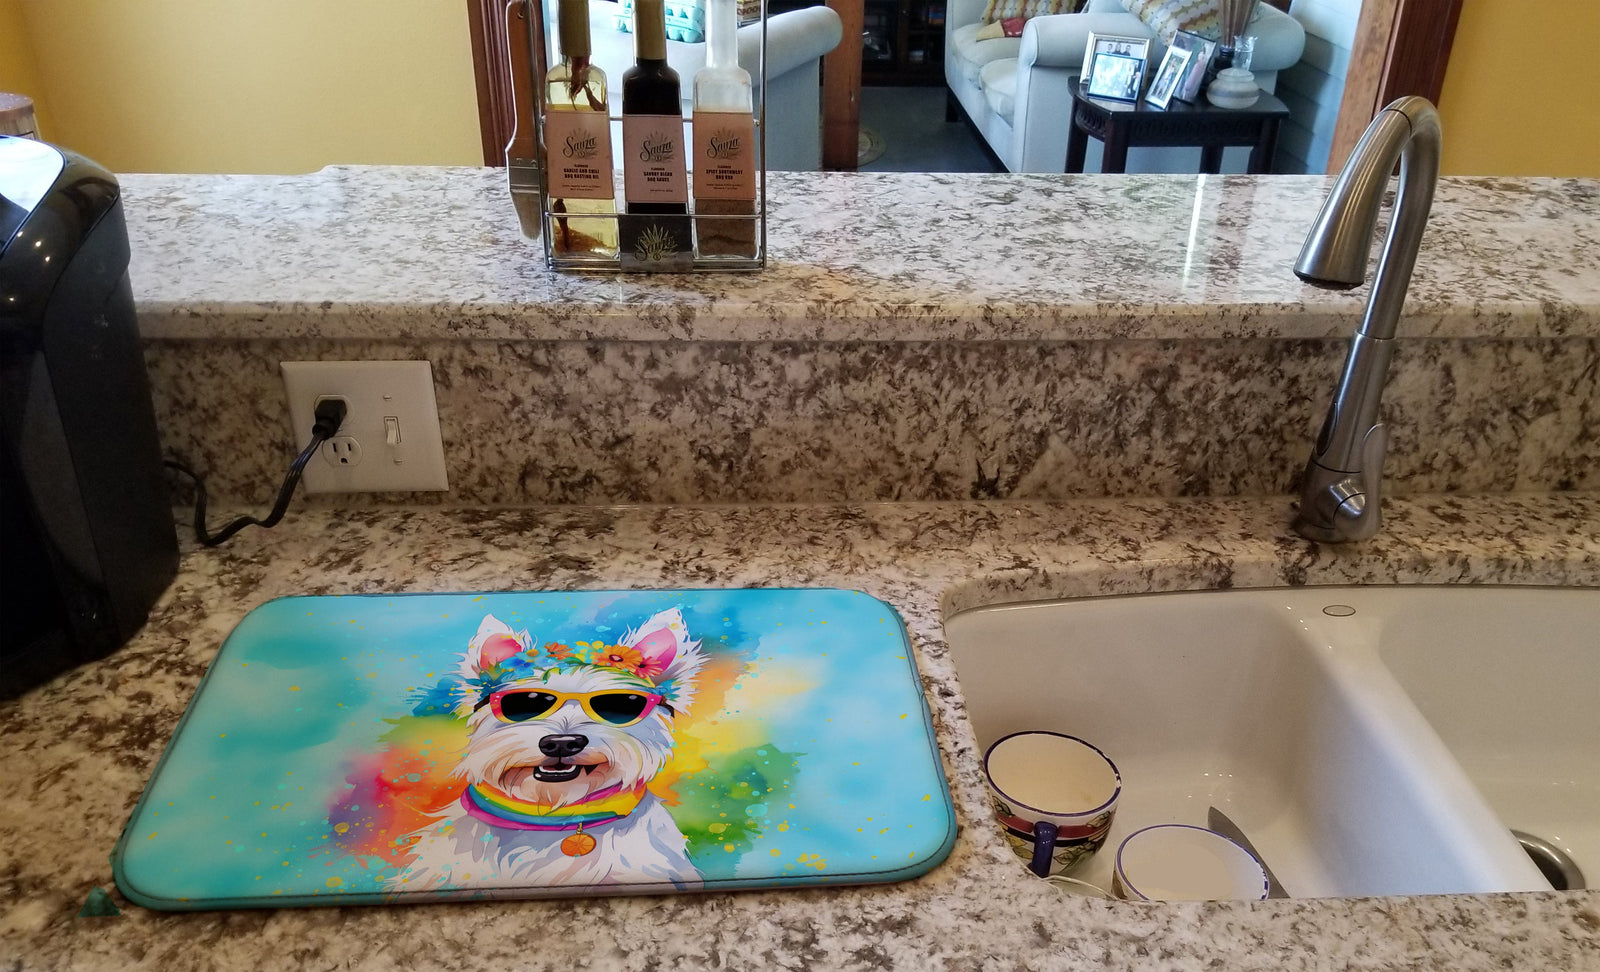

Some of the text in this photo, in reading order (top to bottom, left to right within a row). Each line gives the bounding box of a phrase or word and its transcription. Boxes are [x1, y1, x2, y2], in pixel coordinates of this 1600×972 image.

[562, 135, 597, 158] Sauza
[640, 140, 673, 161] Sauza
[707, 136, 740, 158] Sauza
